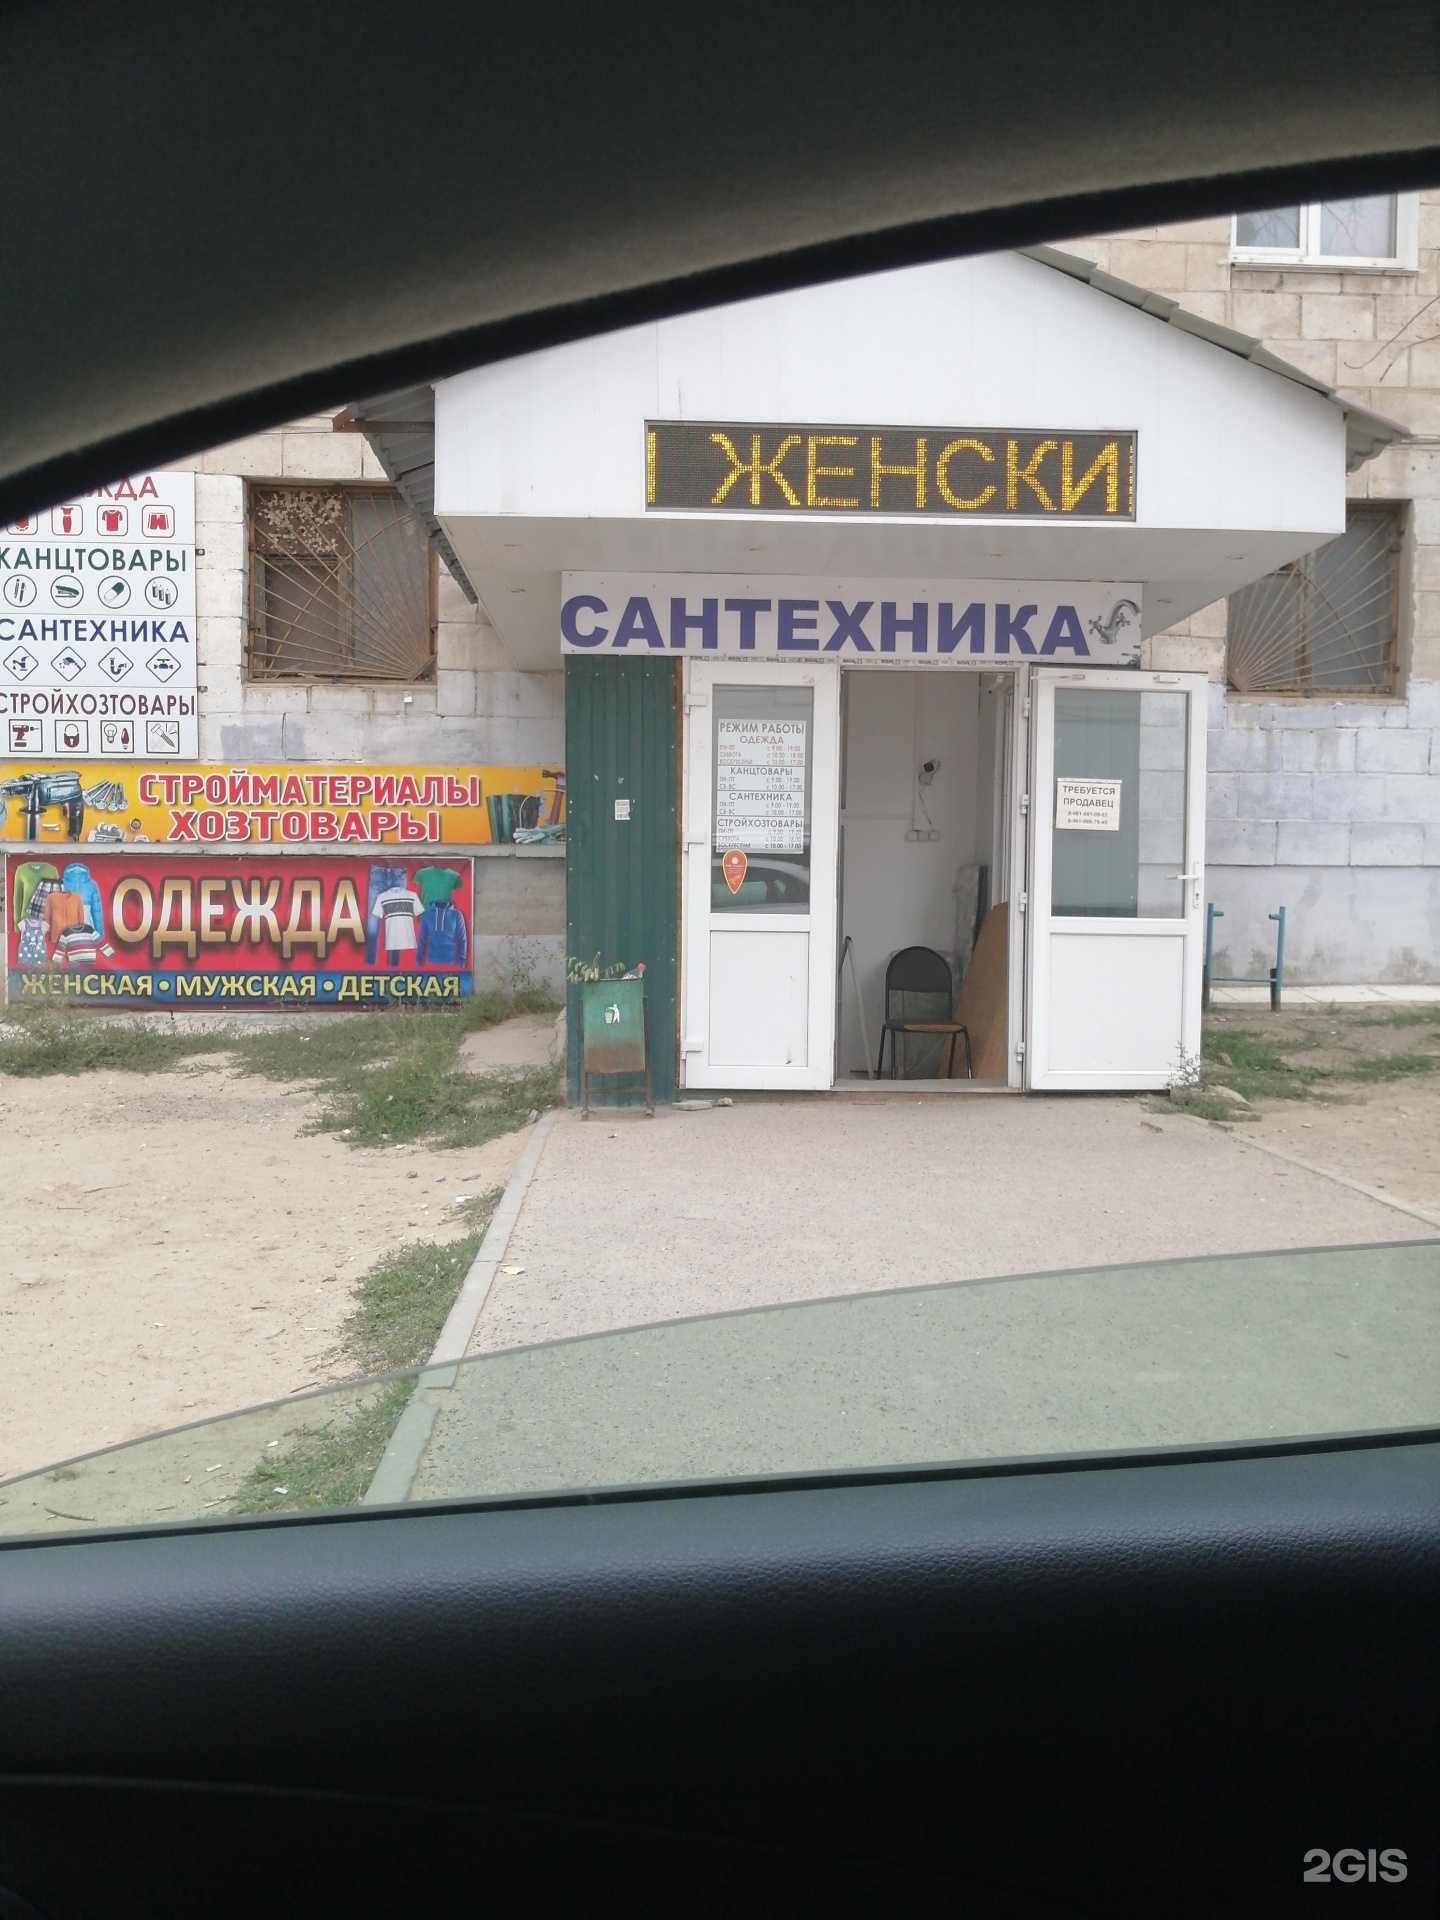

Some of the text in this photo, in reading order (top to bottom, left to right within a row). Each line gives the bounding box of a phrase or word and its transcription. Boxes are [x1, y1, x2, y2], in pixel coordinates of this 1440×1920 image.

[709, 432, 1134, 513] ЖЕНСКИ
[0, 547, 186, 573] КАНЦТОВАРЫ
[0, 618, 189, 643] САНТЕХНИКА
[560, 595, 1091, 656] САНТЕХНИКА
[720, 723, 804, 734] РЕЖИМ РАБОТЫ
[740, 736, 784, 745] ОДЕЖДА
[730, 767, 793, 776] КАНЦТОВАРЫ
[139, 770, 480, 806] СТРОЙМАТЕРИАЛЫ
[729, 793, 793, 801] САНТЕХНИКА
[1063, 786, 1115, 795] ТРЕБУЕТСЯ
[1063, 798, 1114, 808] ПРОДАВЕЦ
[168, 811, 440, 842] ХОЗТОВАРЫ
[718, 817, 803, 828] СТРОЙХОЗТОВАРЫ
[111, 877, 366, 959] ОДЕЖДА
[21, 974, 460, 1000] ЖЕНСКАЯ МУЖСКАЯ ДЕТСКАЯ
